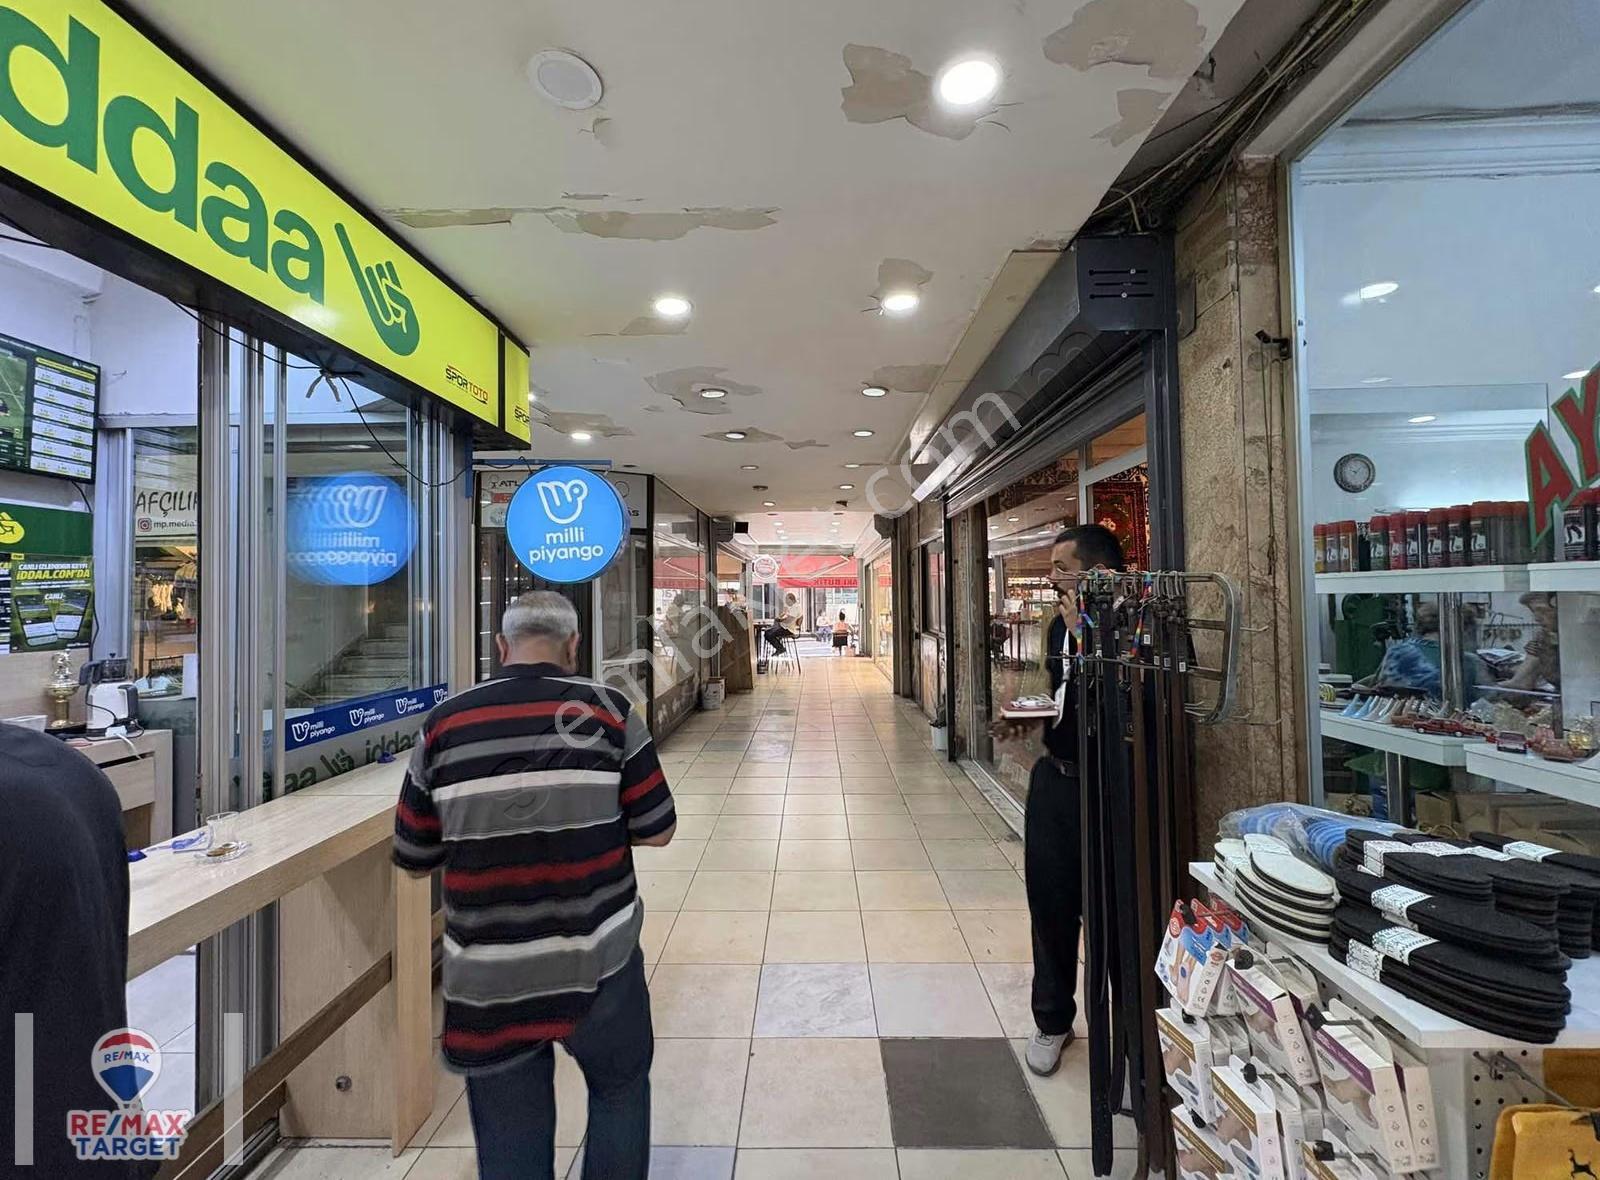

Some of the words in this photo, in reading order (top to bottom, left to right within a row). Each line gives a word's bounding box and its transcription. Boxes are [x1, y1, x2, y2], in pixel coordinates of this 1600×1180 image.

[545, 527, 585, 545] milli
[529, 544, 604, 564] piyango
[310, 721, 324, 732] milli
[310, 726, 336, 739] piyango
